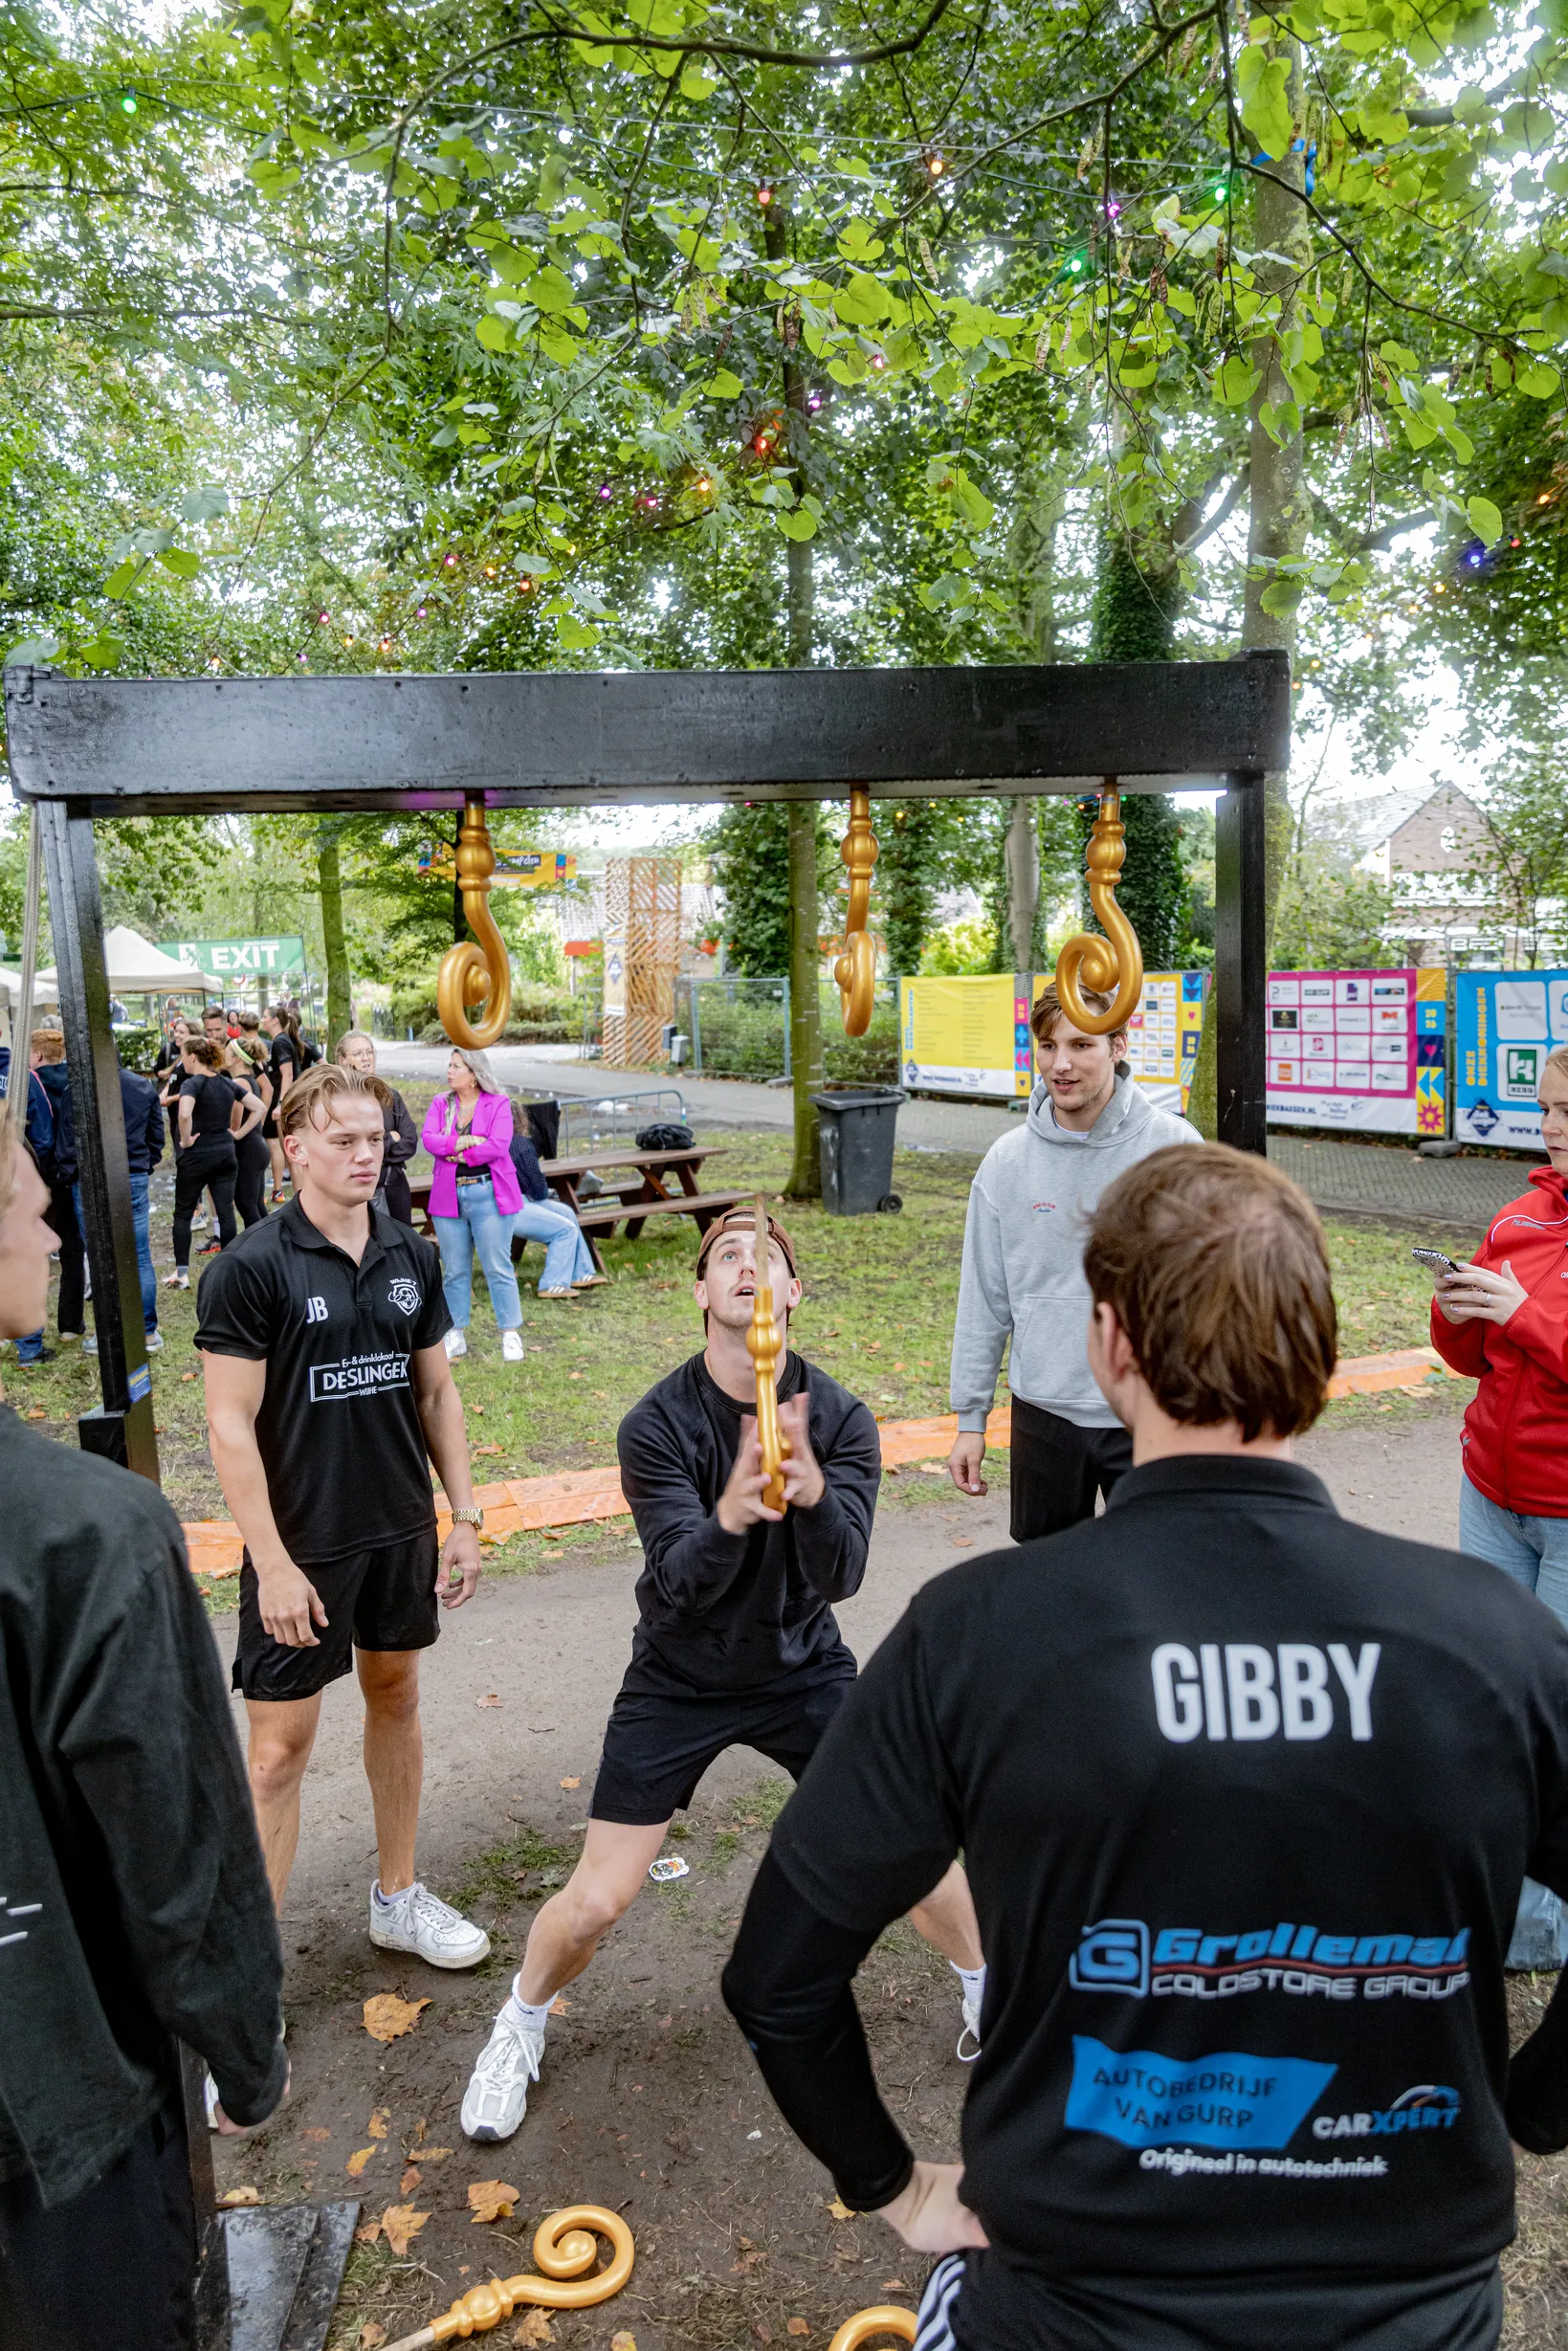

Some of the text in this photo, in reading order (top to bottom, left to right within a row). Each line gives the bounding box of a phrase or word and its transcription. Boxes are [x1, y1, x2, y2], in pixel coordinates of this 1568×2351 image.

[210, 944, 280, 969] EXIT
[306, 1297, 329, 1324] JB
[351, 1356, 358, 1365] &
[358, 1350, 394, 1364] drinklokaal
[1151, 1642, 1381, 1743] GIBBY
[1151, 1967, 1471, 2001] COLDSTORE GROUP
[1093, 2067, 1278, 2099] AUTOBEDRIJF
[1115, 2096, 1253, 2129] VAN GURP
[1312, 2105, 1461, 2140] CARXPERT
[1138, 2146, 1389, 2179] Origineel in autotechniek
